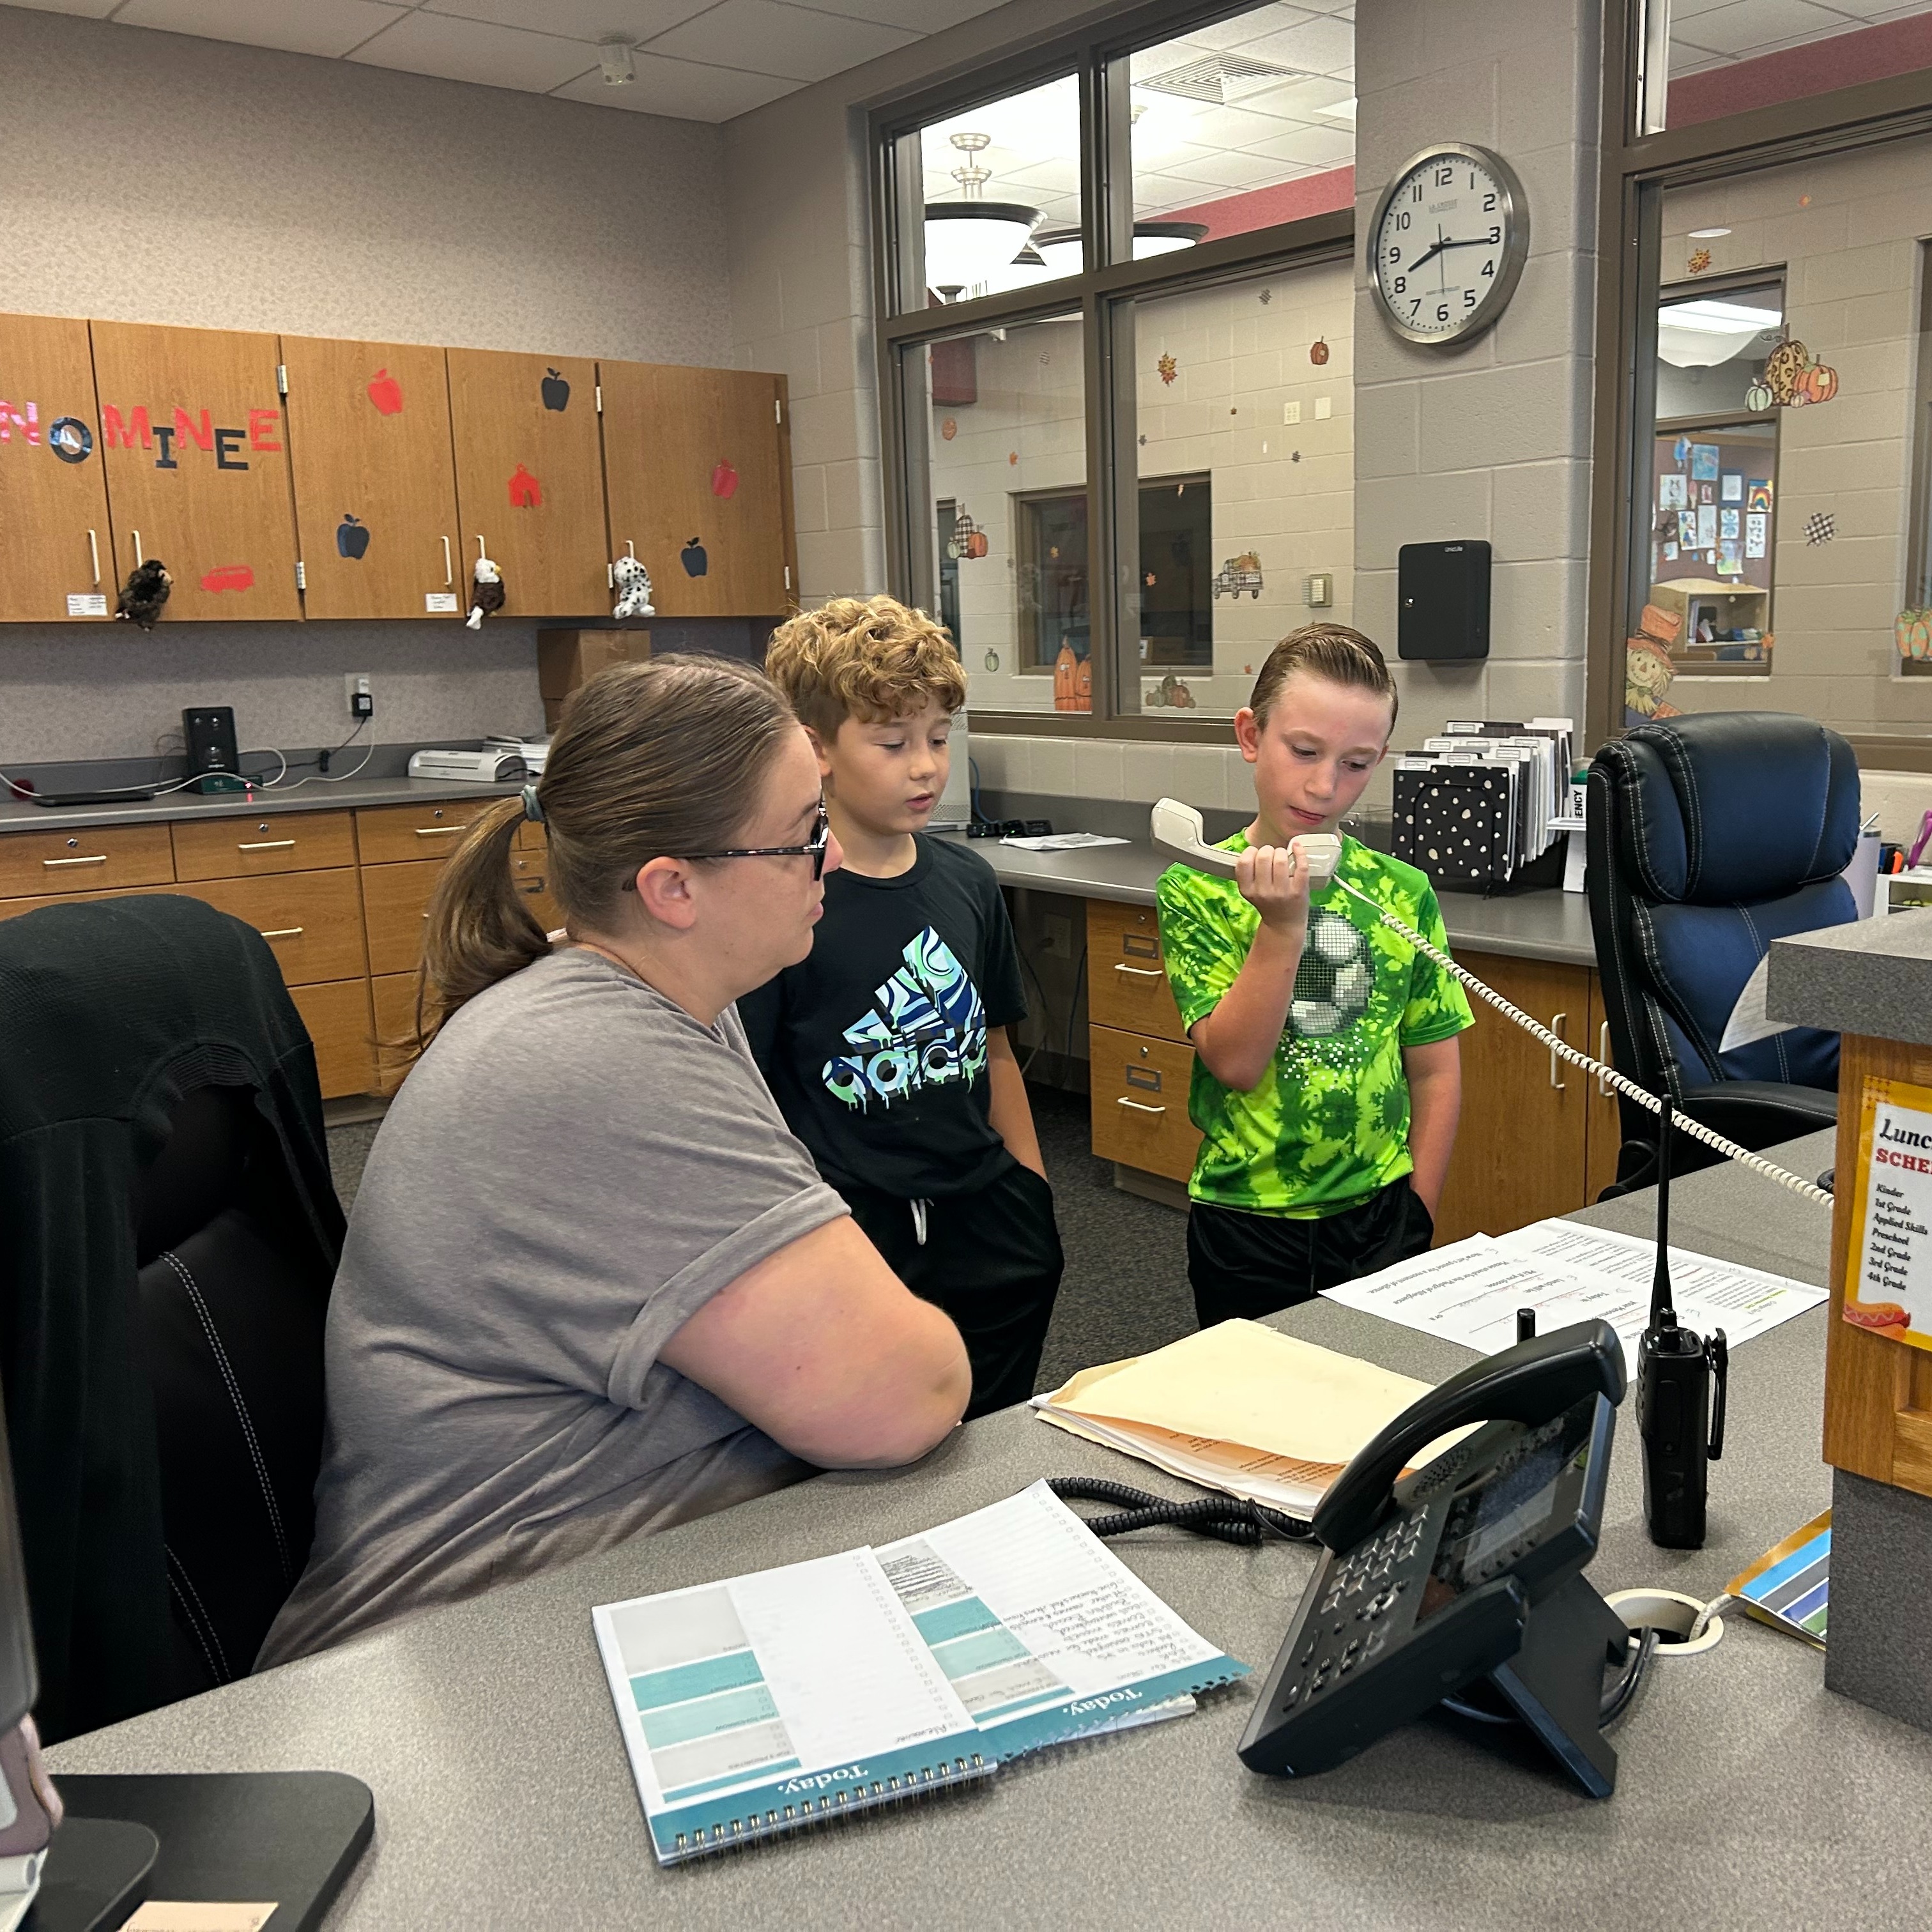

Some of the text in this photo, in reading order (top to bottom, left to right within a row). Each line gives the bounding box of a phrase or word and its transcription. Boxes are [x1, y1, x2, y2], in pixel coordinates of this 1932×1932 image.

[1435, 167, 1452, 187] 12
[1470, 172, 1475, 190] 1
[1413, 184, 1422, 203] 11
[1483, 193, 1496, 212] 2
[1397, 211, 1411, 231] 10
[1489, 226, 1501, 245] 3
[1390, 247, 1400, 264] 9
[1481, 259, 1494, 277] 4
[1395, 276, 1406, 293] 8
[1410, 298, 1421, 317] 7
[1464, 289, 1476, 308] 5
[1437, 303, 1449, 322] 6
[1574, 790, 1583, 818] ENCY
[1880, 1118, 1932, 1149] Lunc
[1876, 1148, 1932, 1174] SCHE
[1876, 1183, 1905, 1198] Kinder
[1875, 1198, 1912, 1215] 1st Grade
[1873, 1213, 1928, 1236] Applied Skills
[1872, 1227, 1910, 1245] Preschool
[1870, 1242, 1912, 1261] 2nd Grade
[1868, 1257, 1908, 1276] 3rd Grade
[1867, 1271, 1906, 1291] 4th Grade
[1062, 1688, 1142, 1717] Today.
[777, 1765, 868, 1794] Today.
